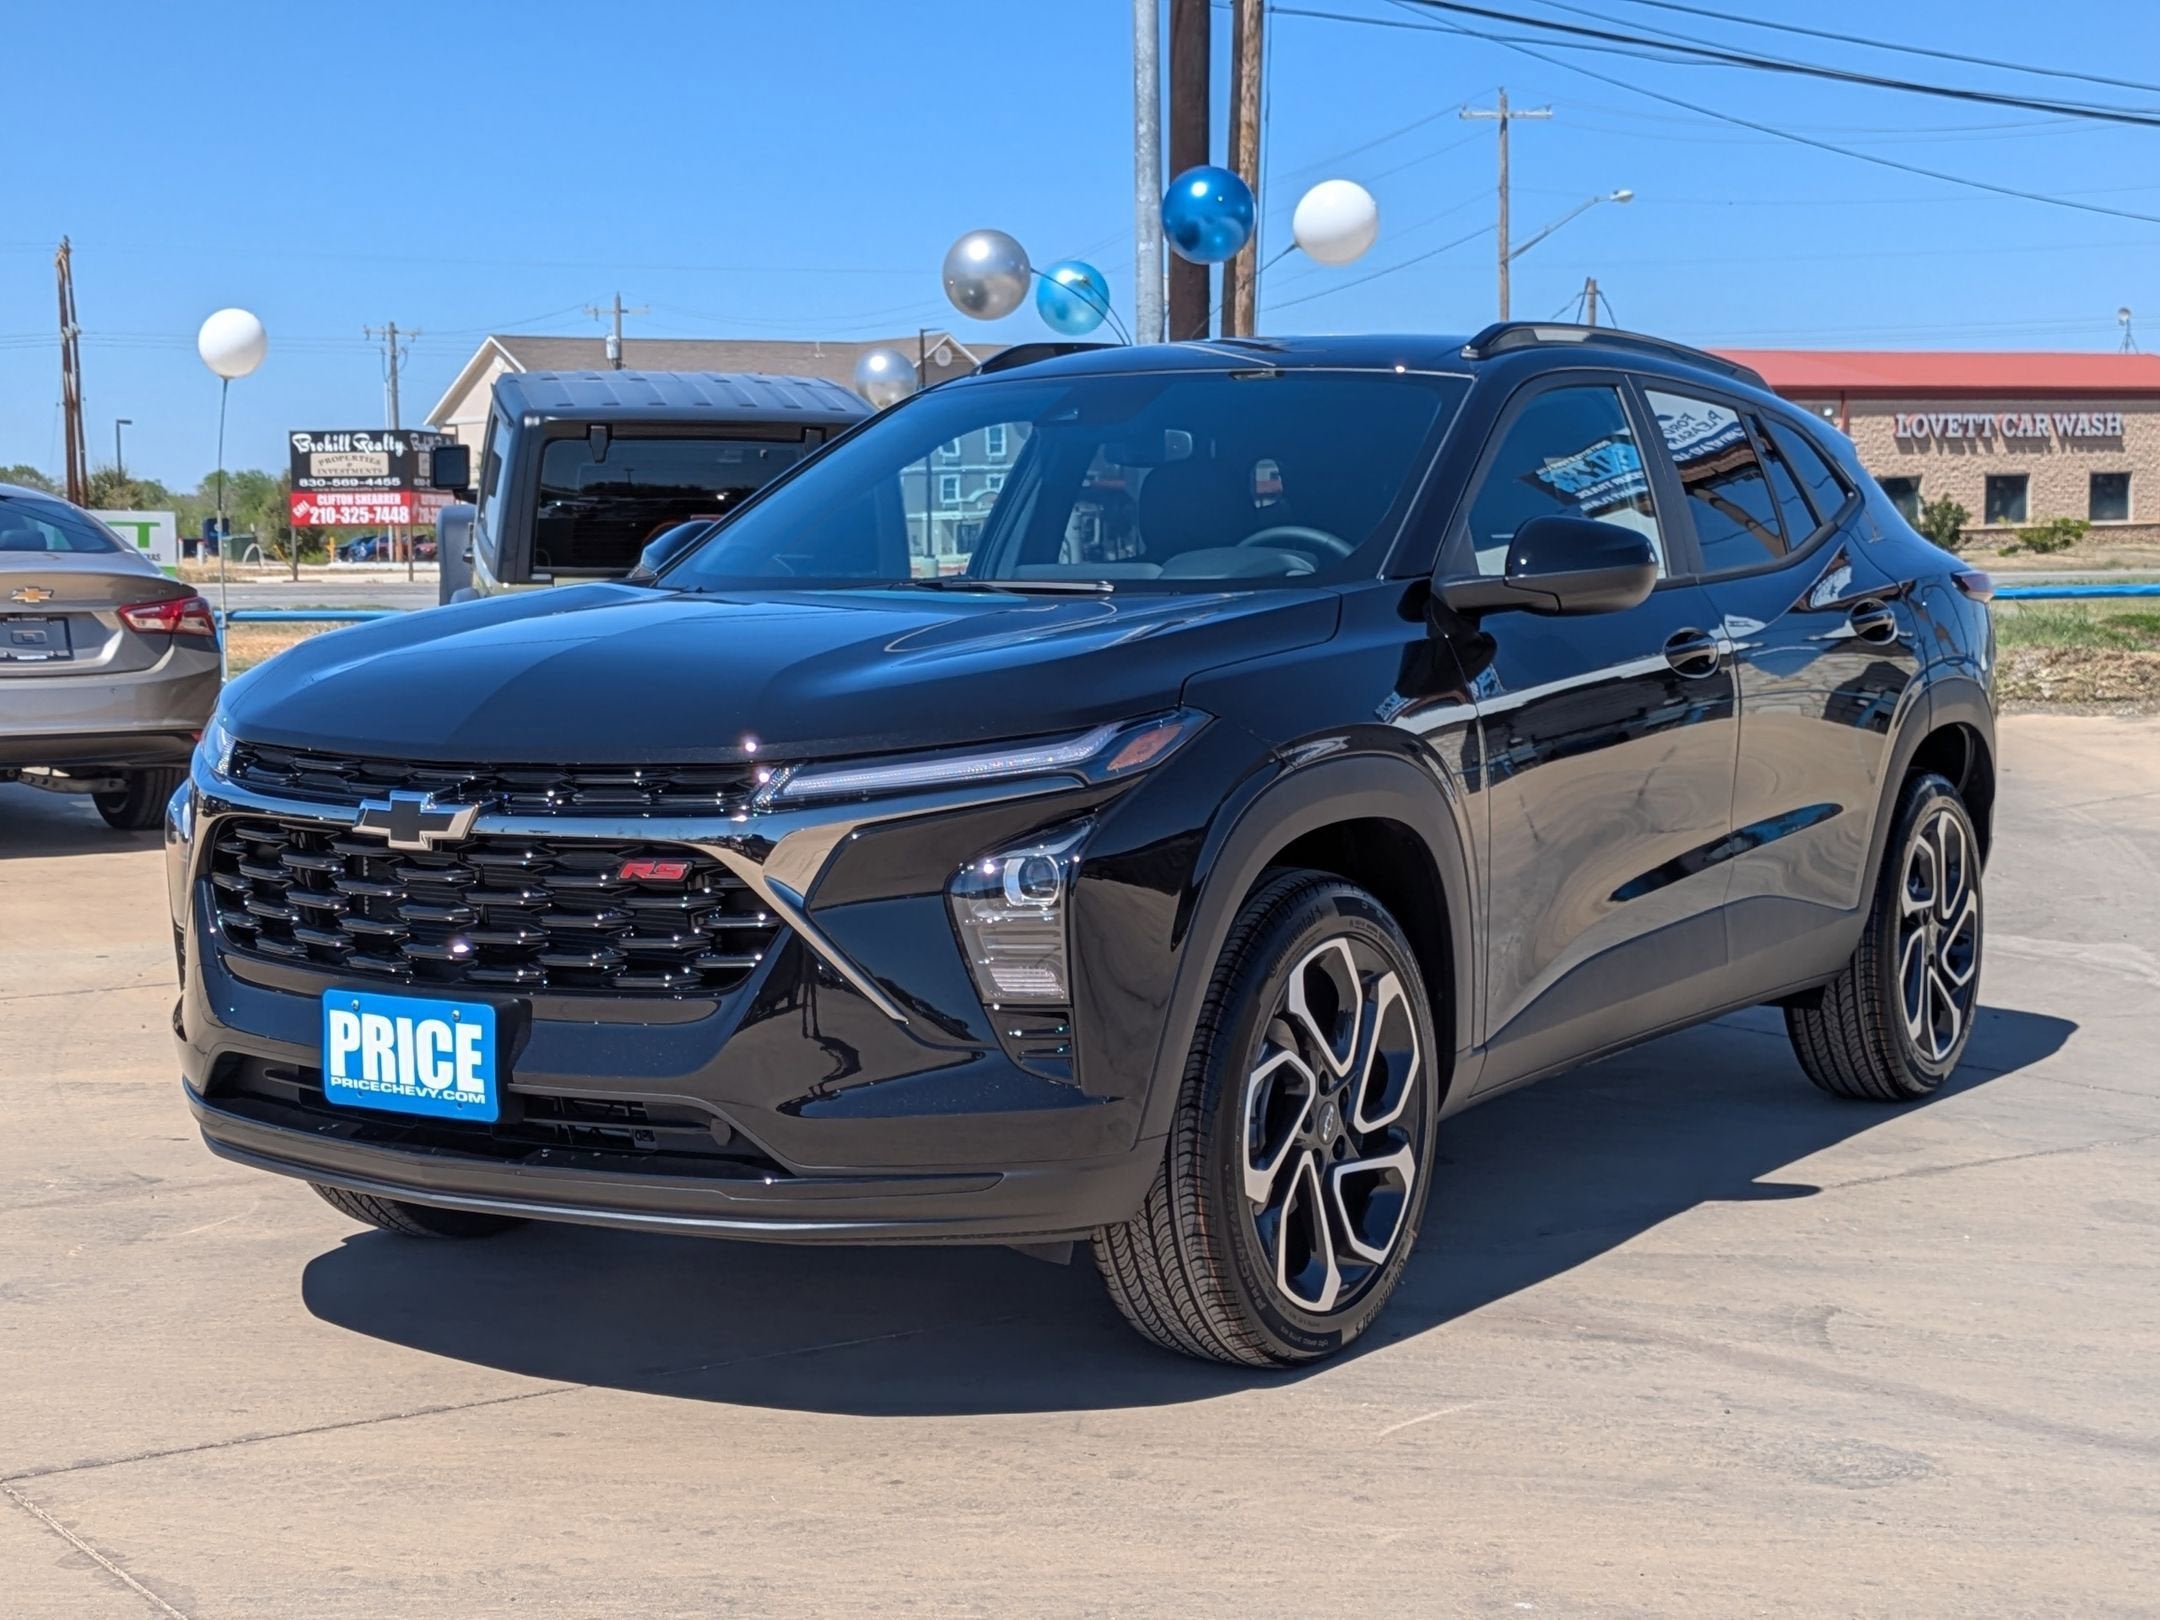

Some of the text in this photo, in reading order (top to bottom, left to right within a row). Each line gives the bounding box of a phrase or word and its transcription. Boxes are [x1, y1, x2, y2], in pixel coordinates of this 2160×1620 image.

[1895, 413, 2123, 438] LOVETT CAR WASH
[352, 433, 406, 457] Realty
[318, 454, 382, 467] PROPERTIES
[298, 477, 401, 487] 830-569-4455
[316, 494, 354, 505] CLIFTON
[309, 506, 410, 524] 210-325-7448
[620, 862, 687, 880] RS
[329, 1009, 485, 1093] PRICE
[330, 1075, 485, 1104] PRICECHEVY.COM
